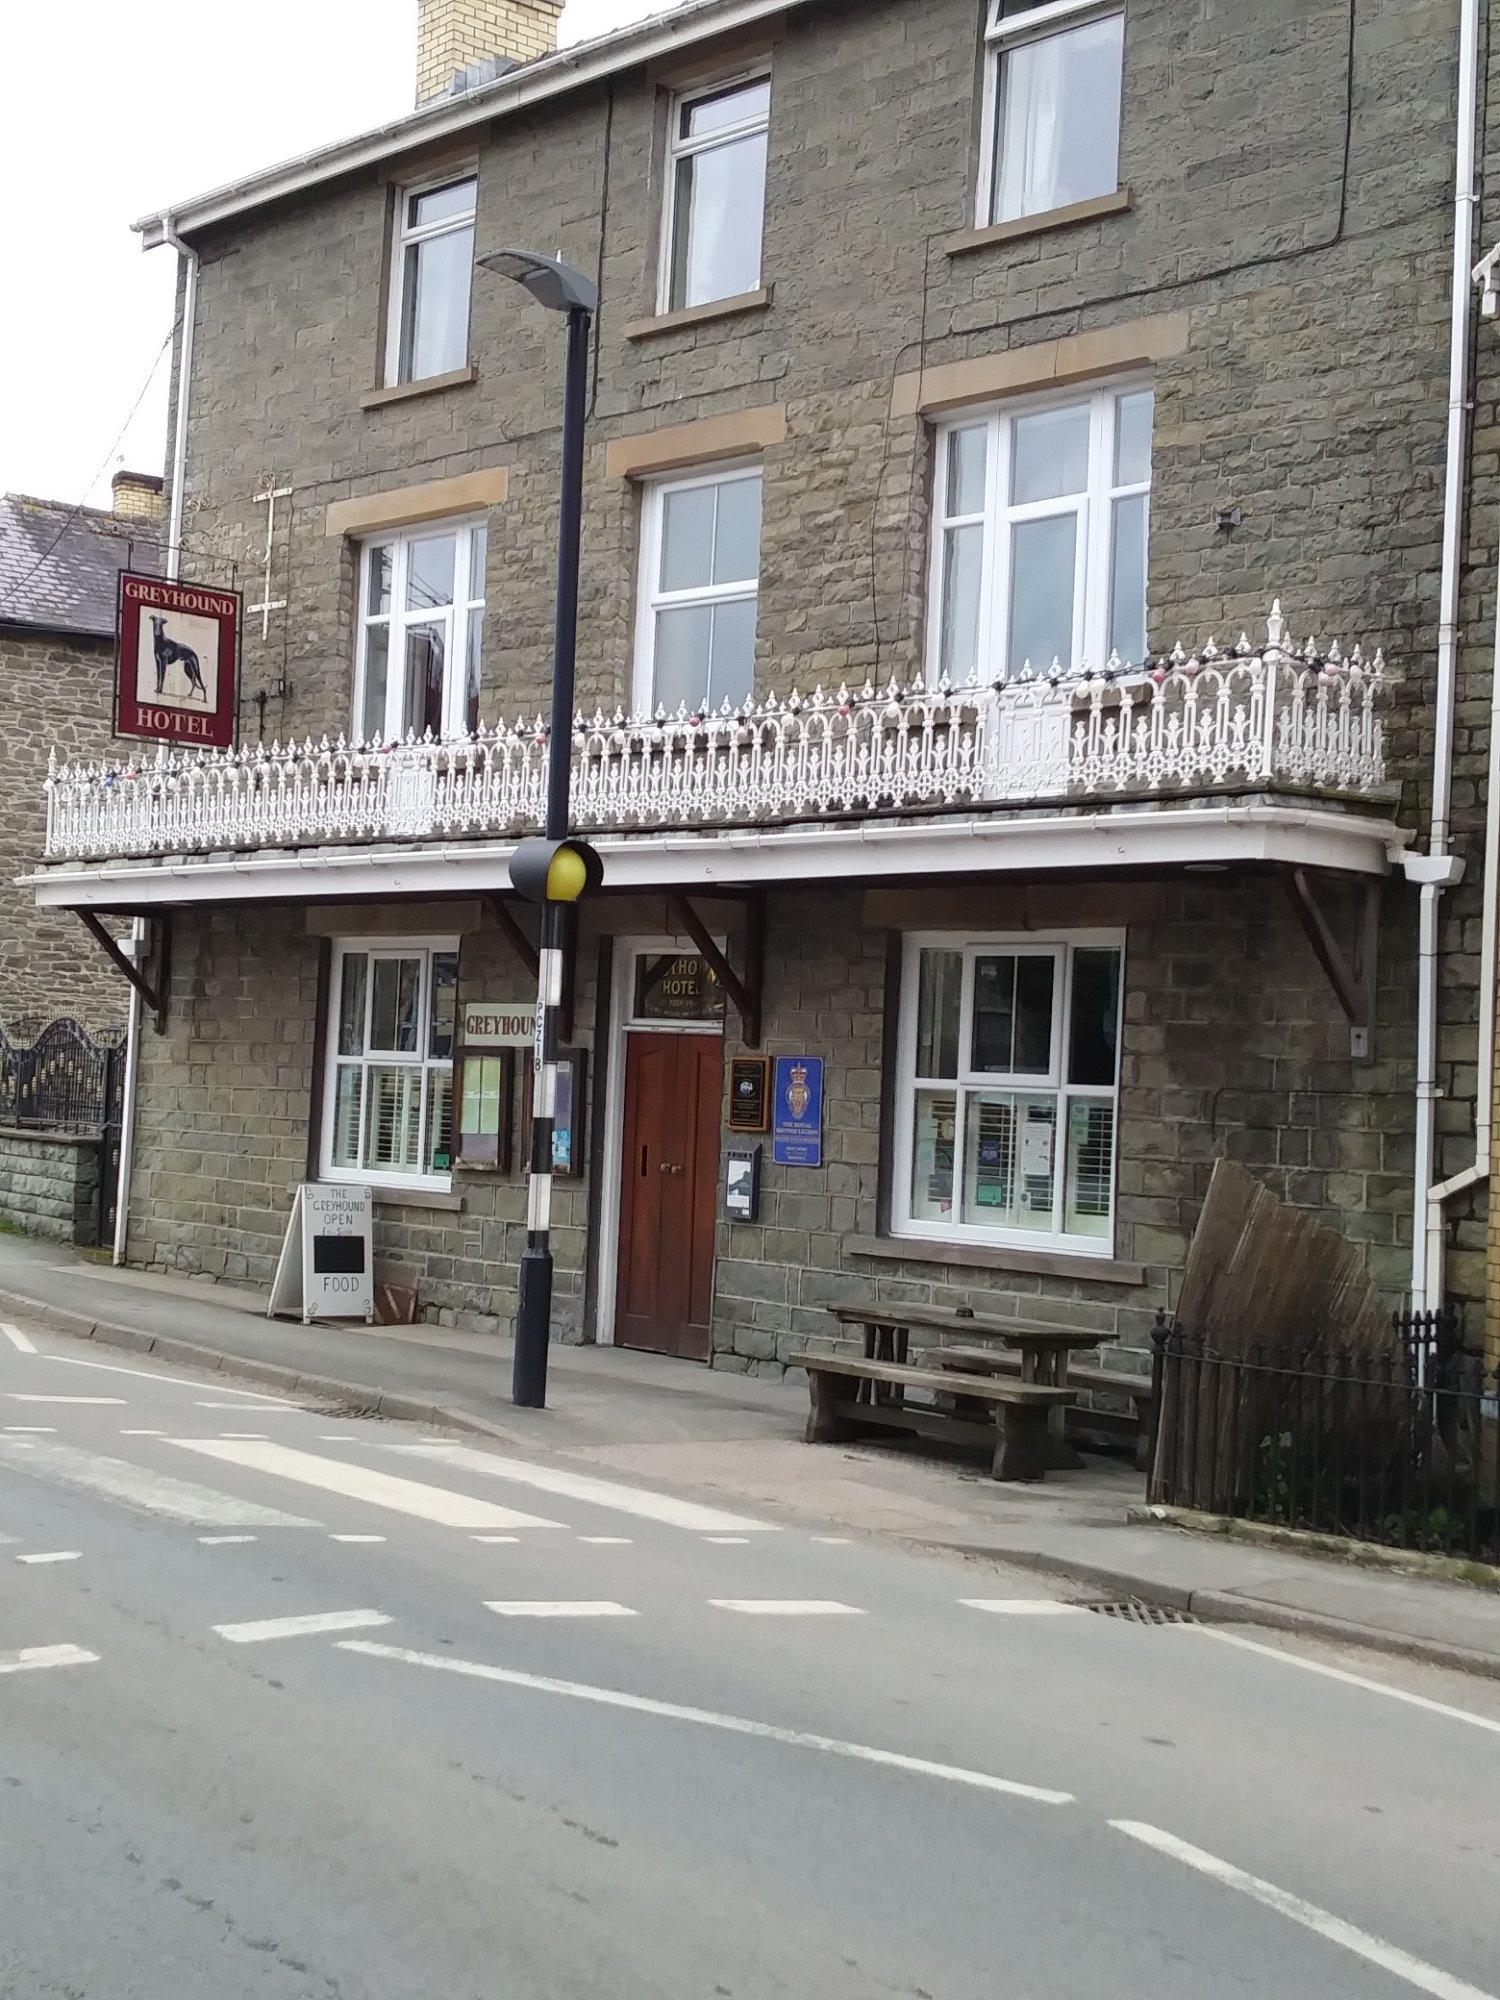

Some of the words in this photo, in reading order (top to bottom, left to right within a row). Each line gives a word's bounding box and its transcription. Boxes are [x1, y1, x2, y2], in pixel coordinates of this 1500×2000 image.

[125, 582, 234, 616] GREYHOUND
[136, 708, 214, 738] HOTEL
[466, 1015, 537, 1036] GREYHOUN
[330, 1188, 347, 1199] THE
[313, 1200, 365, 1212] GREYHOUND
[324, 1213, 353, 1225] OPEN
[323, 1276, 360, 1293] FOOD
